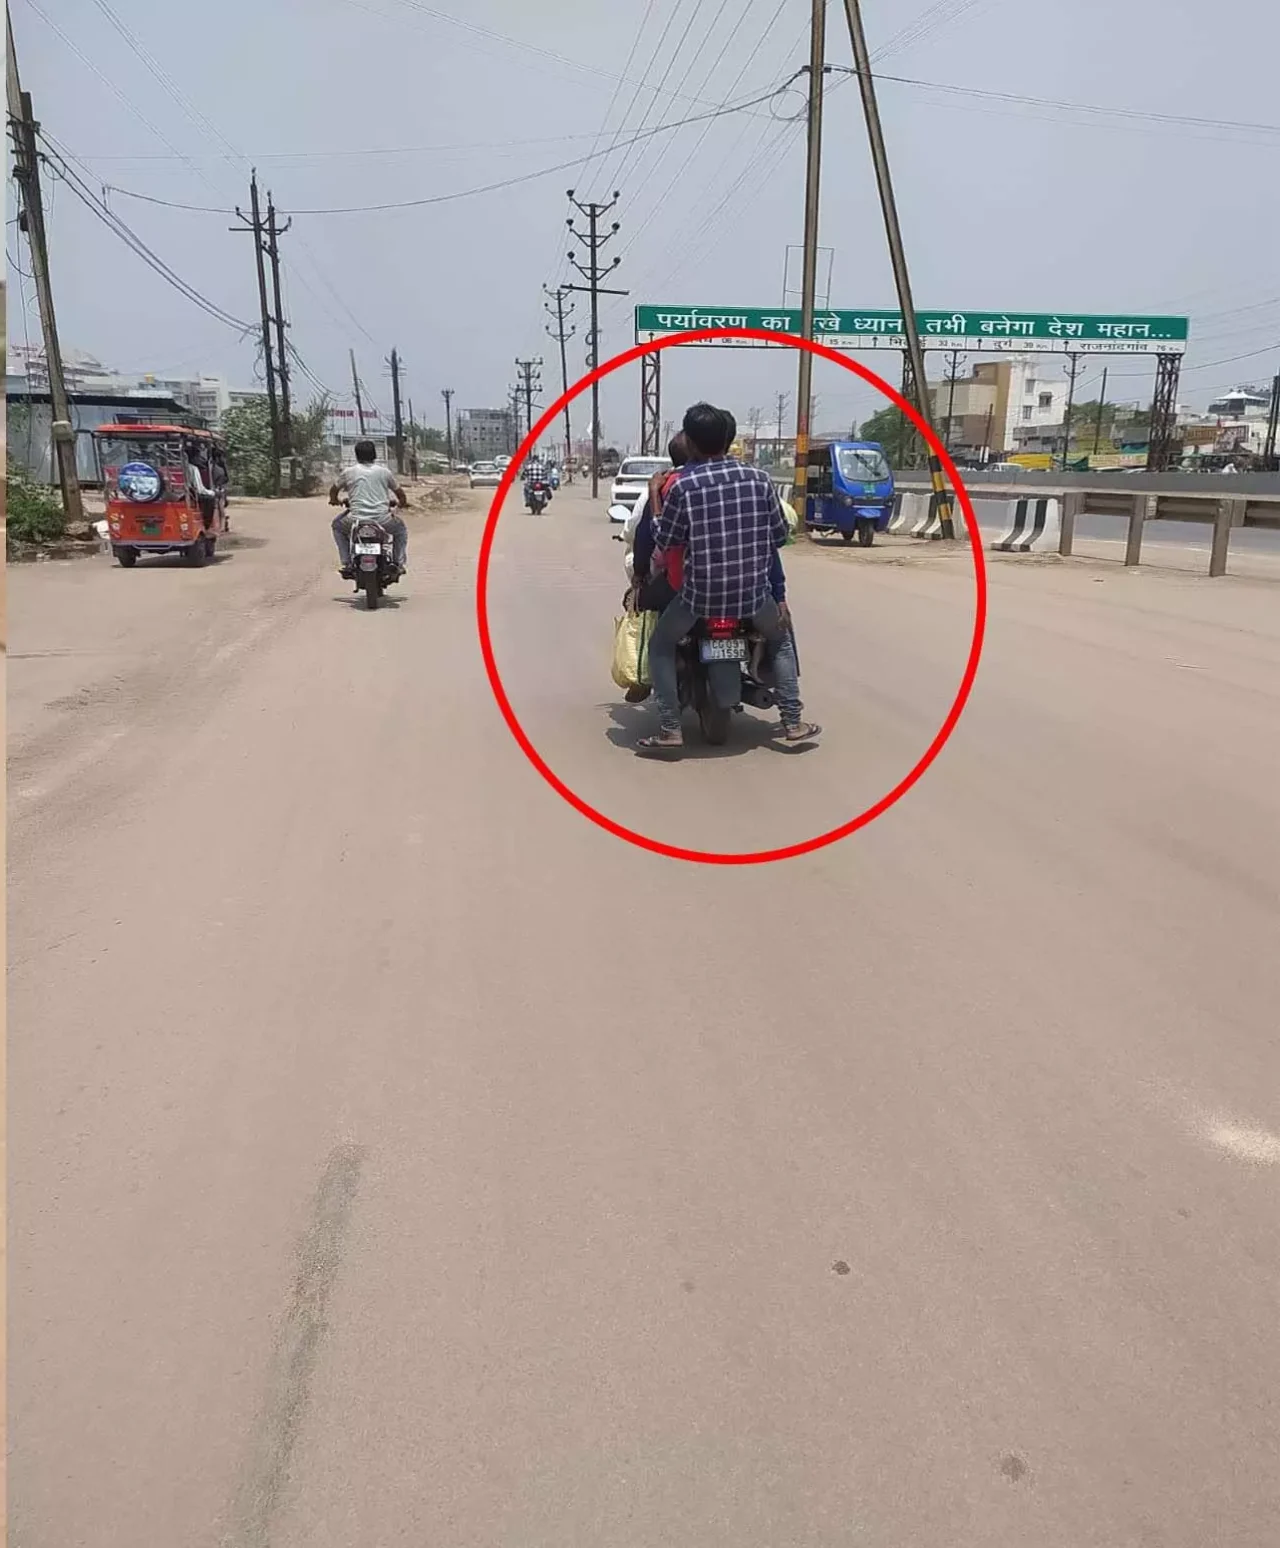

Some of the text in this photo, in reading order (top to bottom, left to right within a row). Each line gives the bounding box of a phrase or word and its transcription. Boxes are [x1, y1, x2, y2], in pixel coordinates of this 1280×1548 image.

[656, 310, 747, 329] पर्यावरण
[761, 316, 791, 330] का
[812, 313, 841, 331] खे
[853, 318, 903, 332] ध्यान
[925, 314, 967, 333] तभी
[979, 316, 1035, 334] बनेगा
[1047, 317, 1084, 336] देश
